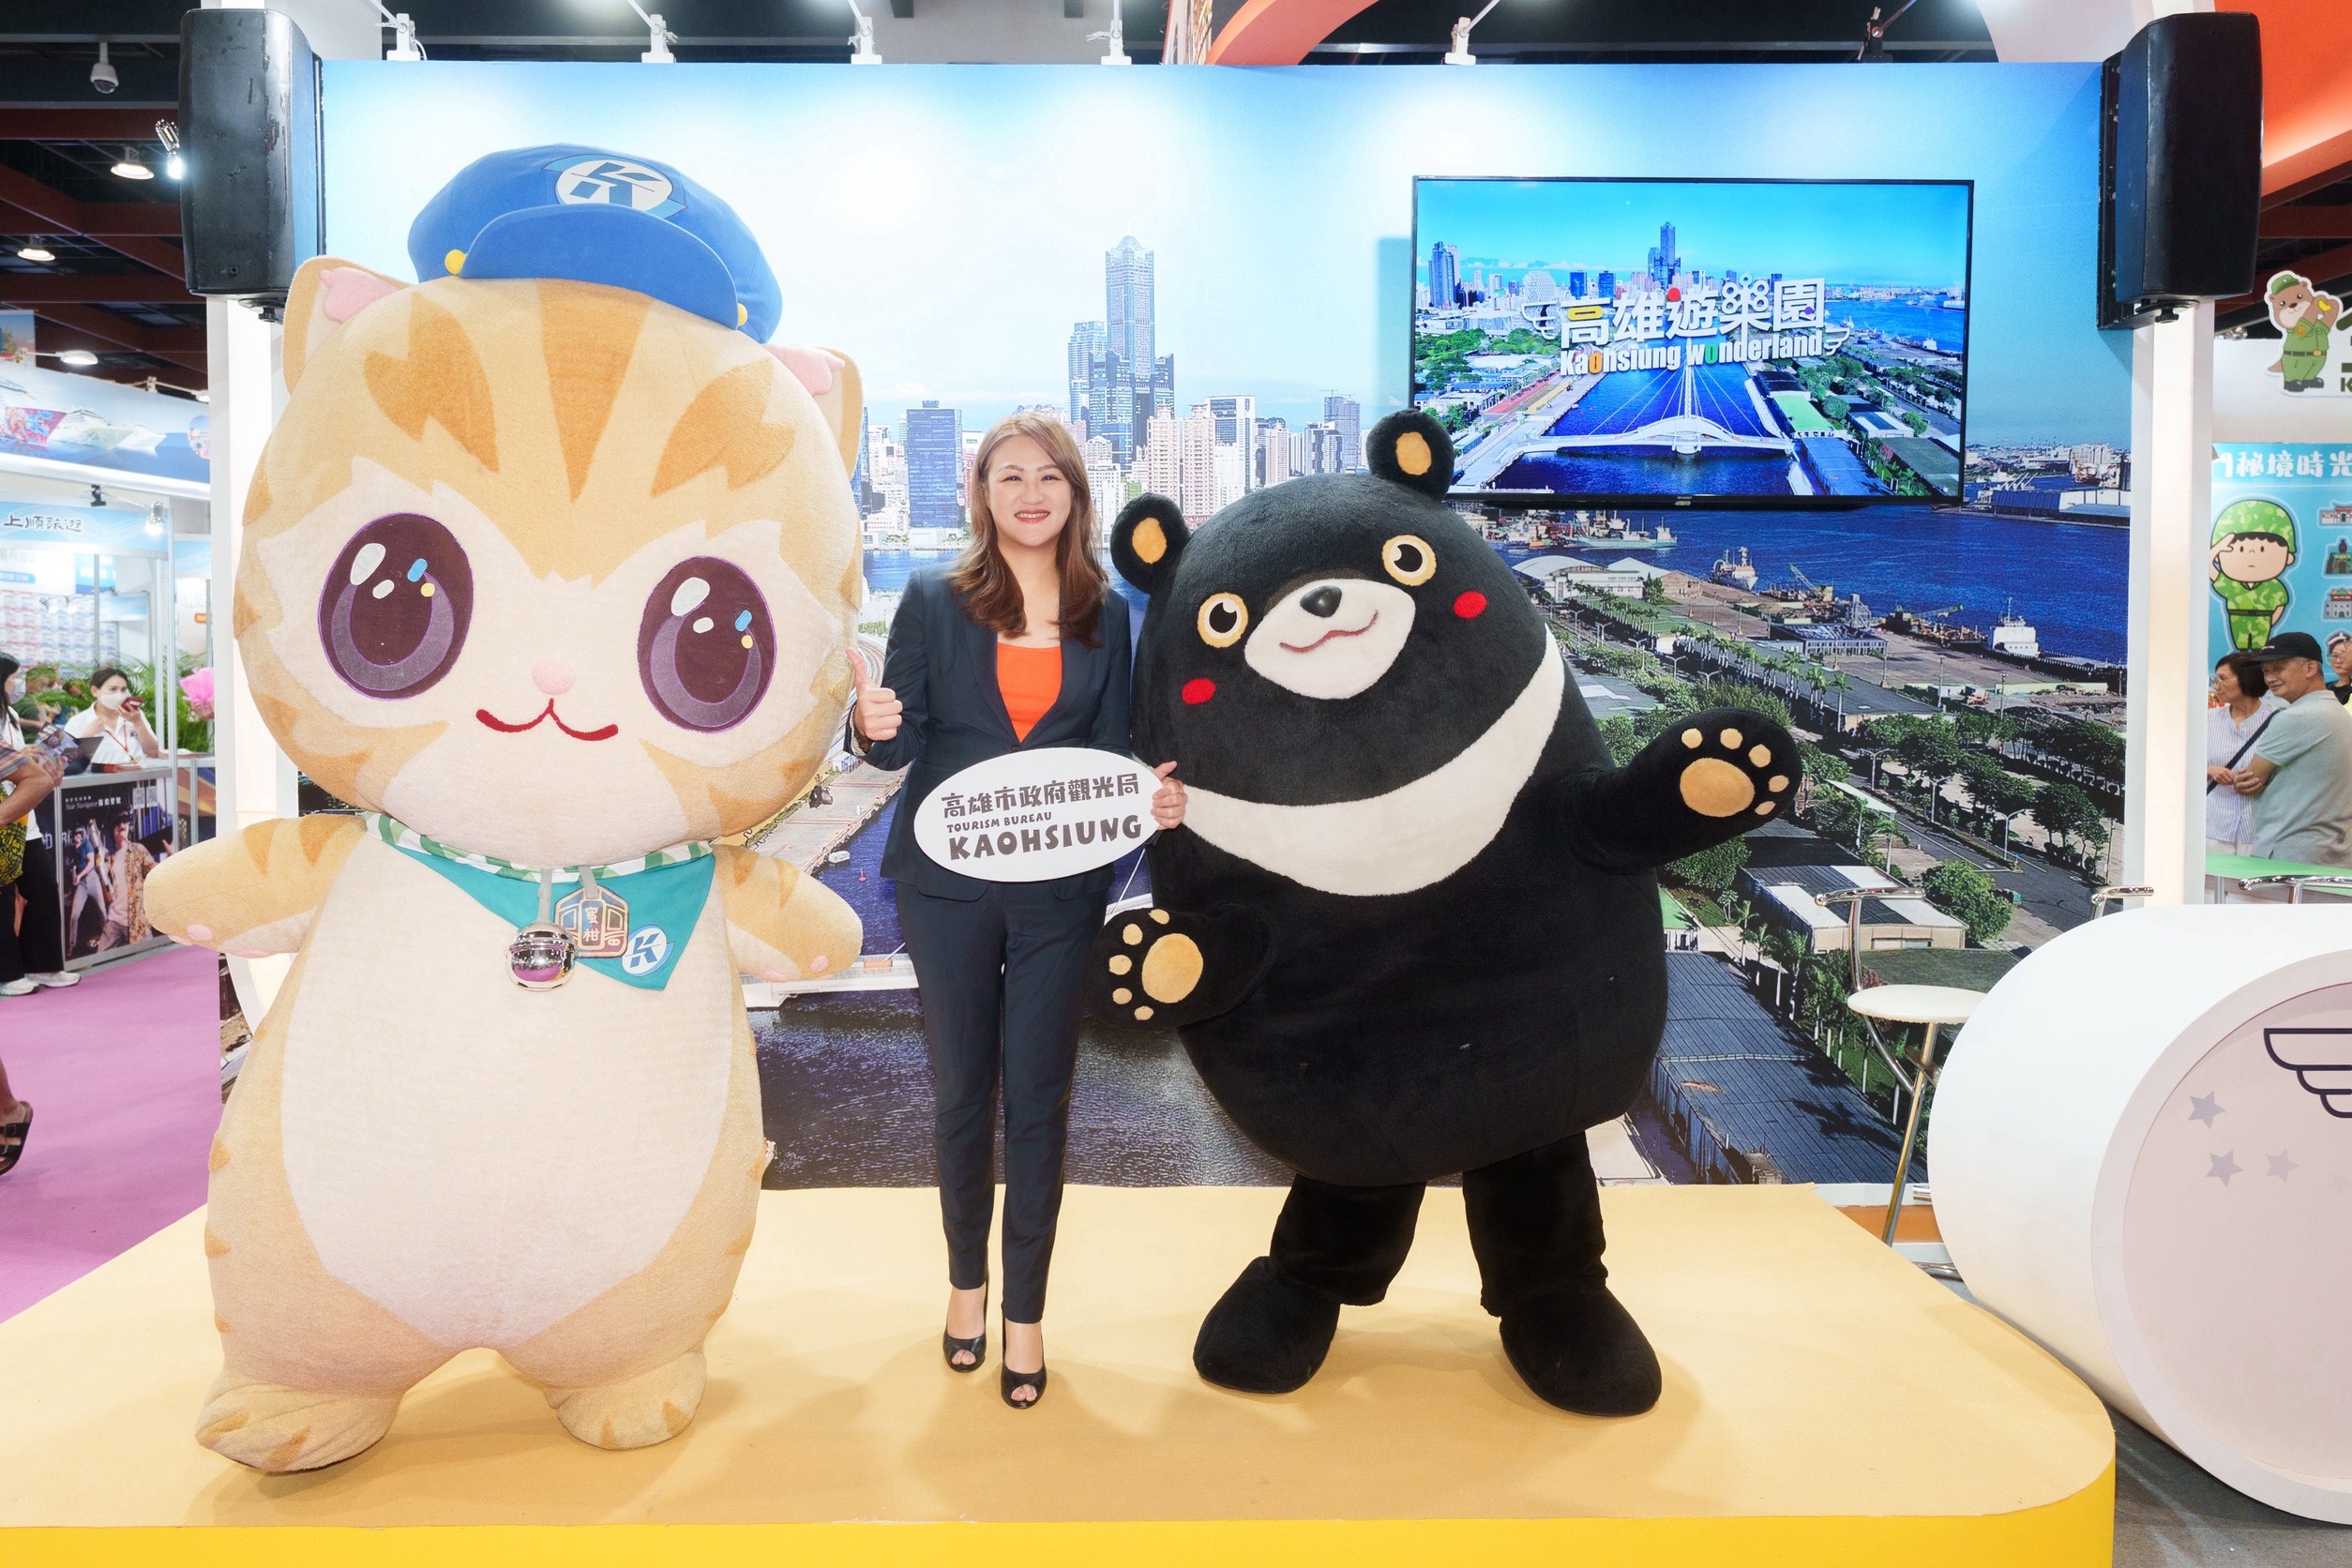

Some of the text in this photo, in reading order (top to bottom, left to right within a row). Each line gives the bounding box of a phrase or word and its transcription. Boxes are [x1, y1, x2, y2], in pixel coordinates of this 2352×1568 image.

[1560, 273, 1826, 348] 高雄遊樂園
[1560, 344, 1681, 376] Kaohsiung
[4, 515, 83, 533] 上順旅遊
[942, 773, 1139, 819] 高雄市政府觀光局
[947, 811, 1052, 833] TOURISM BUREAU
[948, 814, 1141, 860] KAOHSIUNG
[582, 906, 600, 942] 蜜柑
